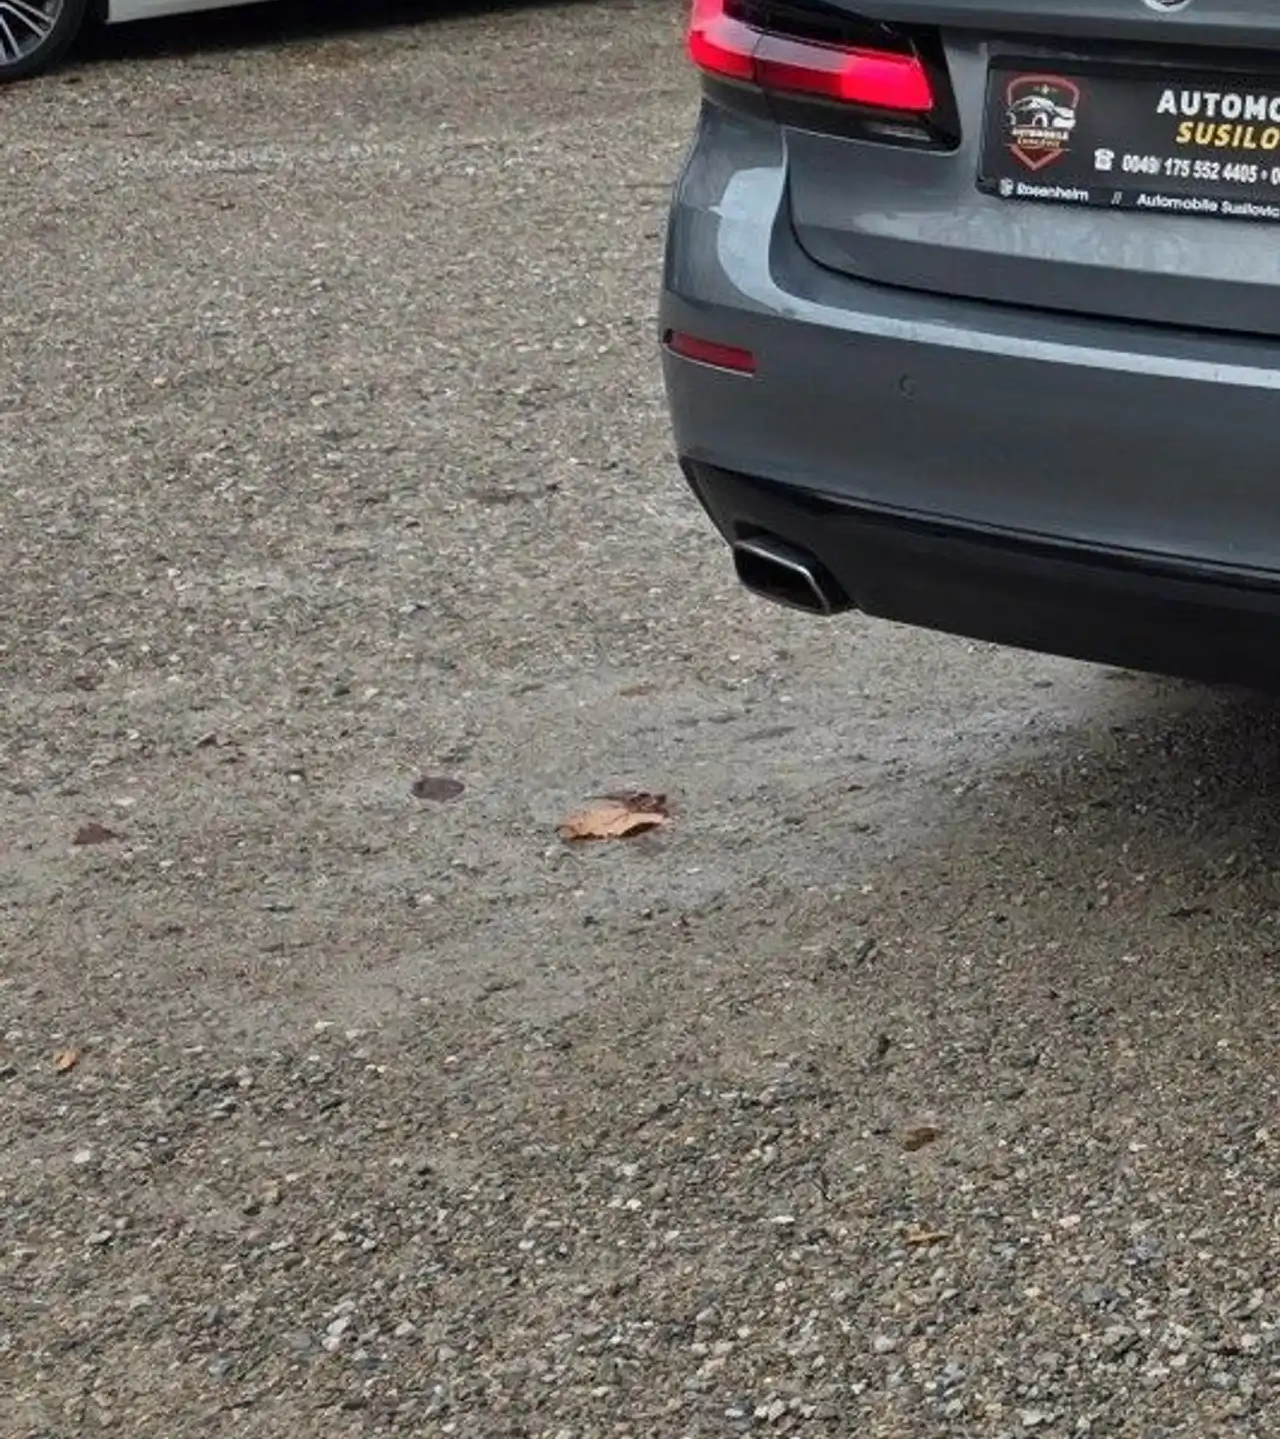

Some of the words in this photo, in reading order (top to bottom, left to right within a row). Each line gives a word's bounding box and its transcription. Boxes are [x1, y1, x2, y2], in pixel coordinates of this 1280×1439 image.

[1165, 156, 1190, 178] 175
[1193, 158, 1219, 181] 552
[1222, 162, 1257, 183] 4405
[1015, 182, 1089, 200] Rosenheim
[1136, 193, 1218, 213] Automobile
[1220, 200, 1280, 218] Susilovic
